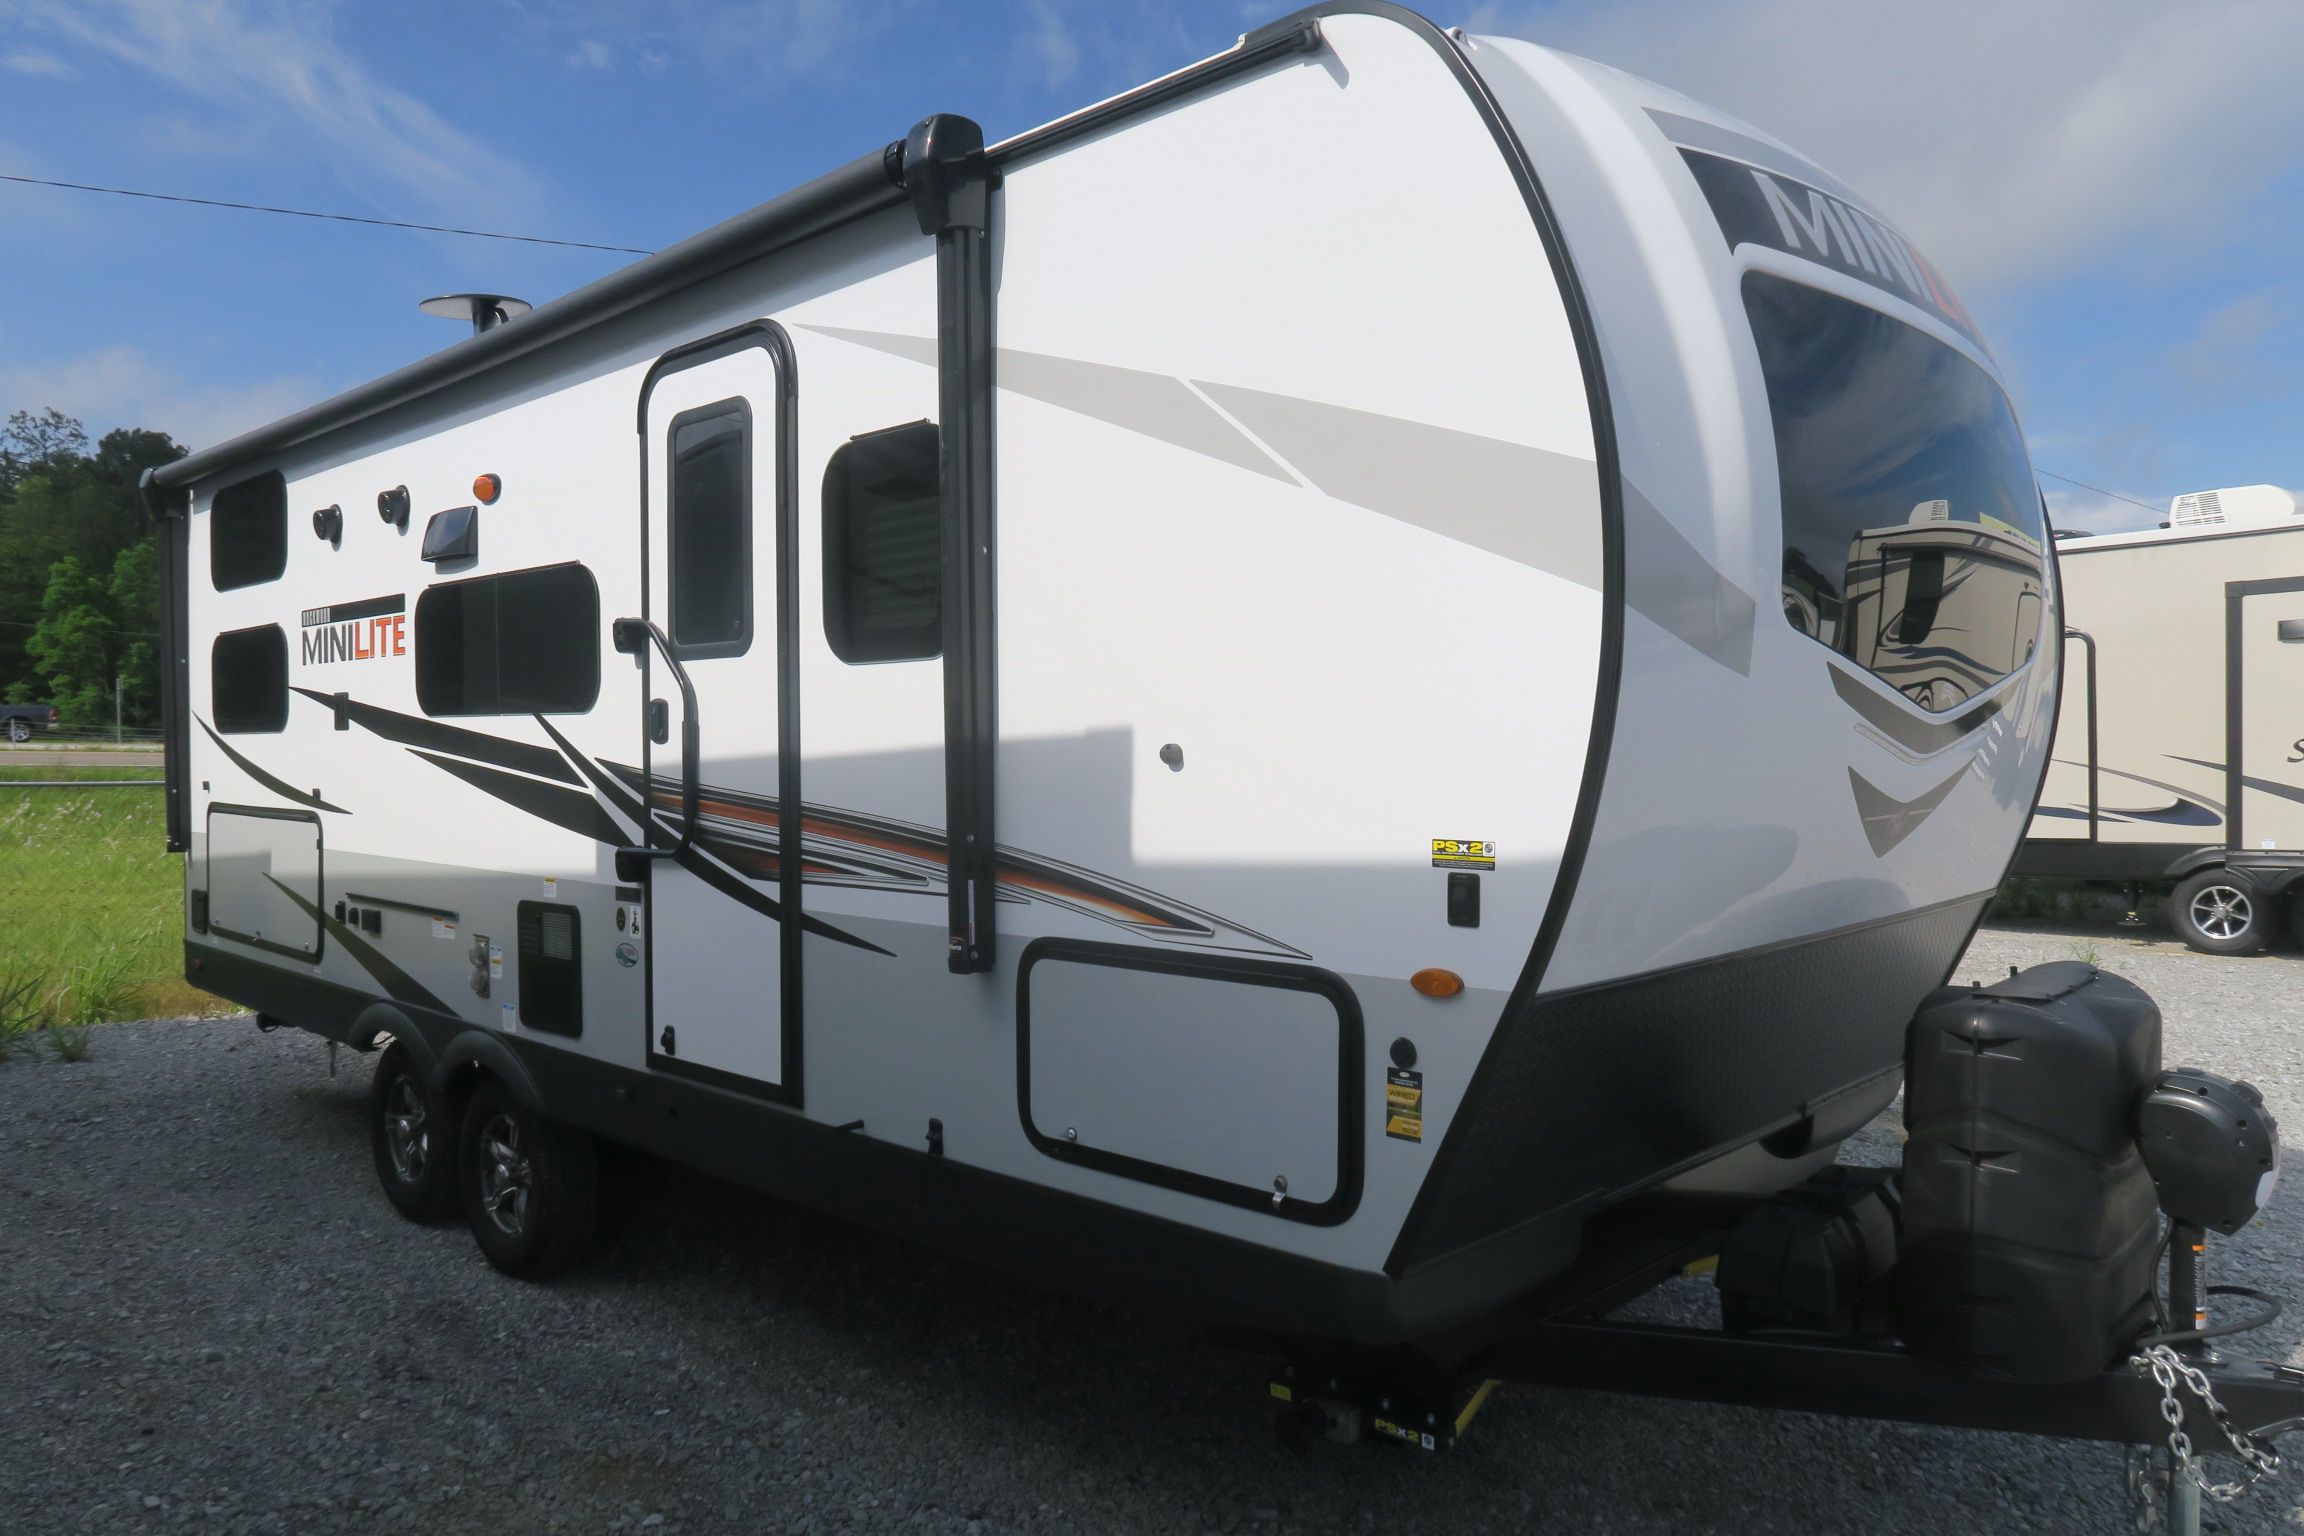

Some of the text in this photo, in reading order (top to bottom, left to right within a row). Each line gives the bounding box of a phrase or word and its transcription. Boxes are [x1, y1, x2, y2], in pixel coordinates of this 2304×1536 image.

[302, 614, 406, 666] MINILITE
[2287, 738, 2304, 763] S
[1433, 840, 1483, 854] PSx2
[1389, 1089, 1416, 1100] WIRED
[1375, 1418, 1419, 1441] PSx2
